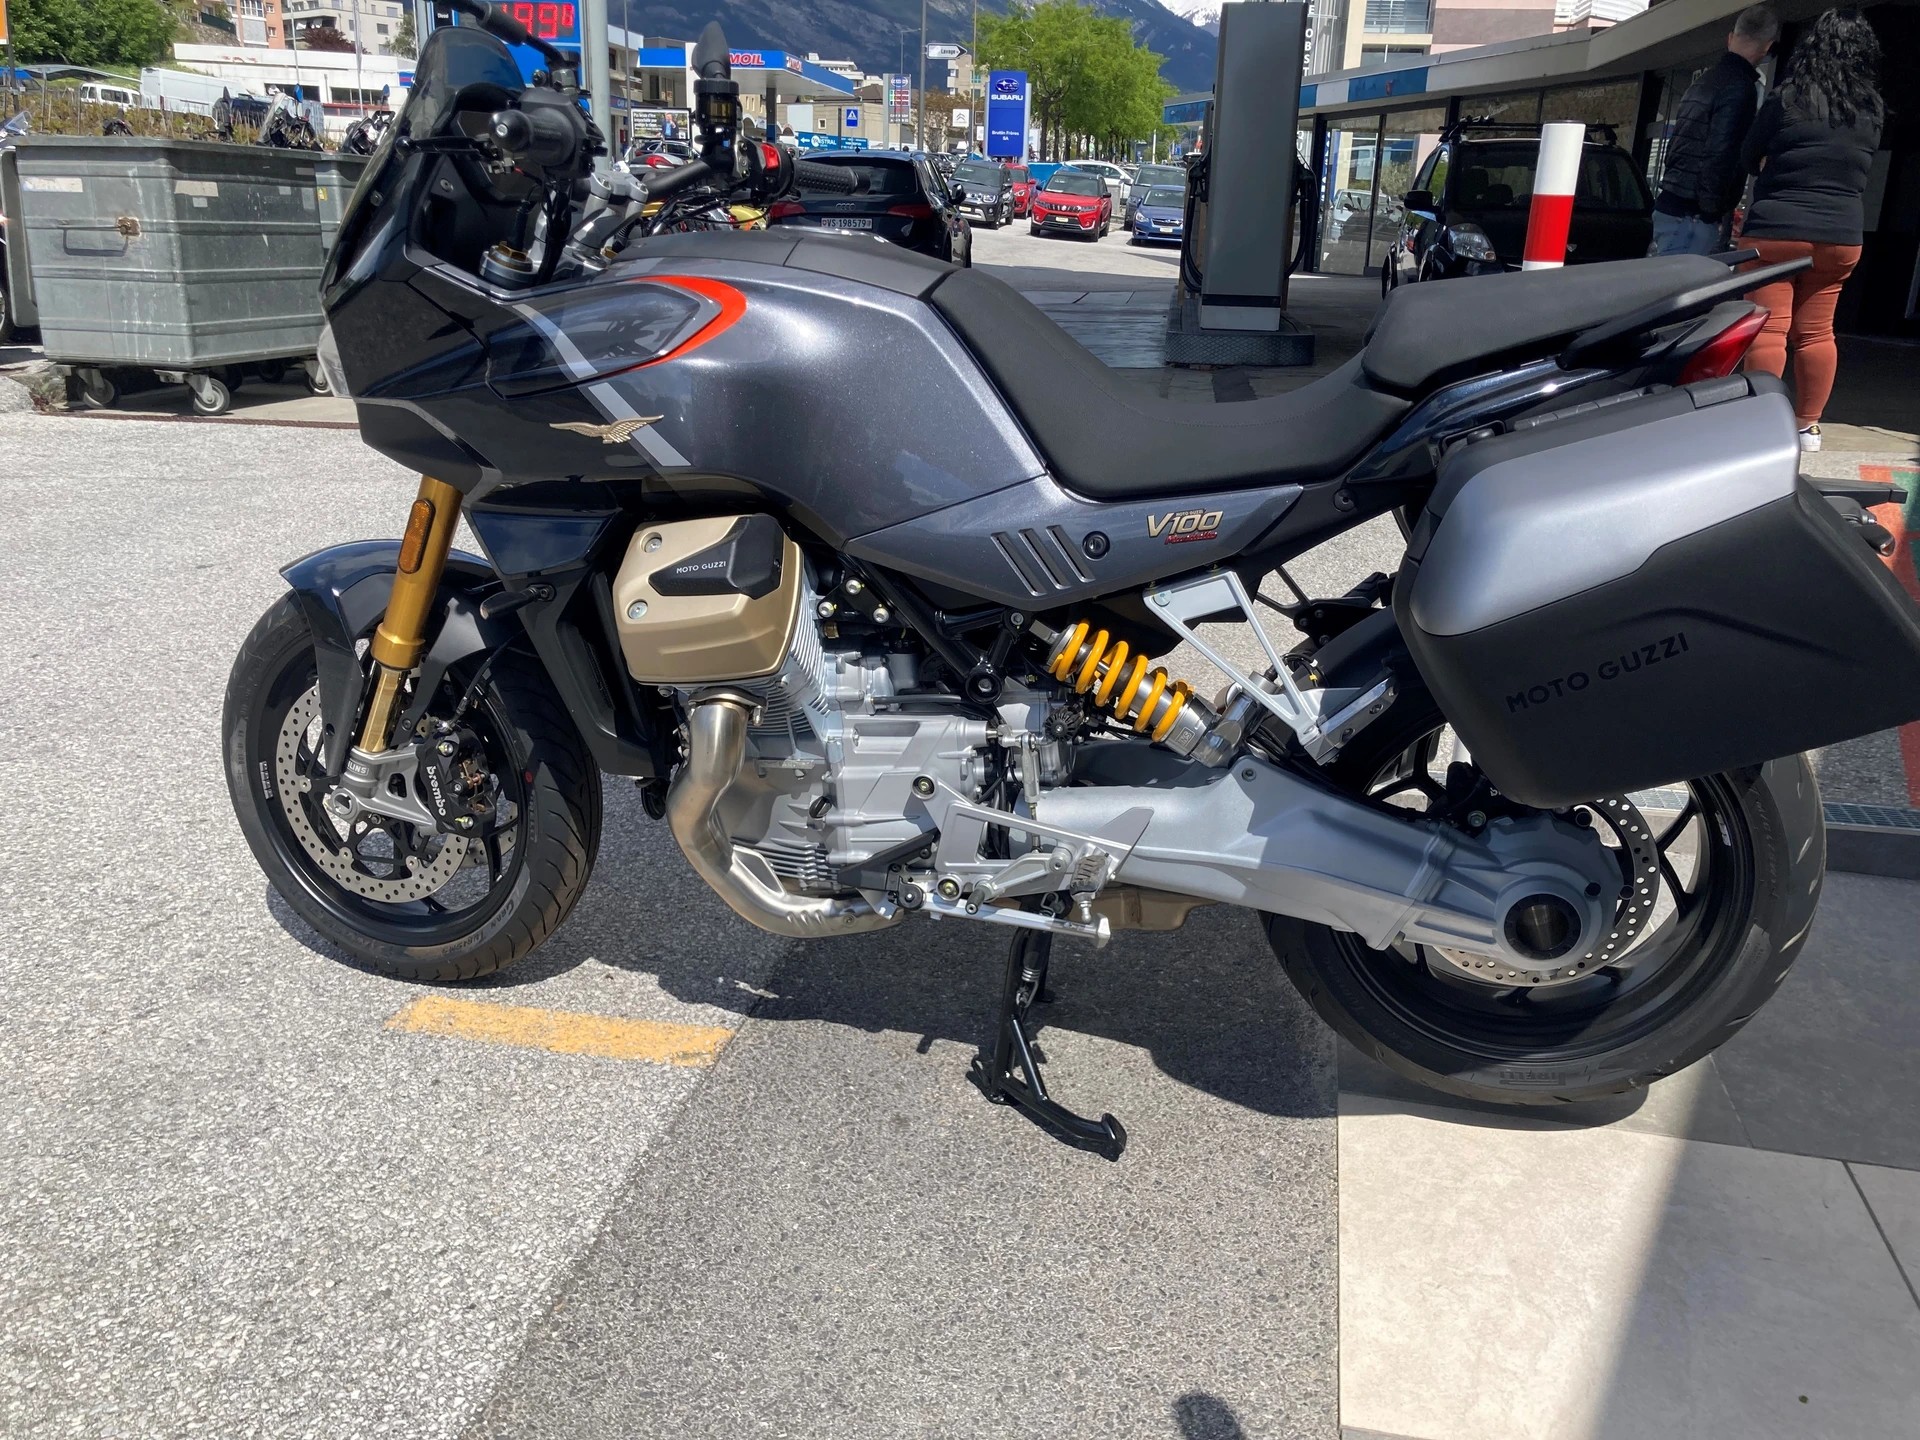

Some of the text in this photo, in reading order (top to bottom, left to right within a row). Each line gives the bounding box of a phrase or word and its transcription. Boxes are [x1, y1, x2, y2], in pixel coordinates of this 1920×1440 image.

[729, 53, 764, 66] MOIL
[827, 219, 866, 228] VS 198579
[1147, 510, 1223, 538] V100
[676, 561, 726, 574] MOTO GUZZI
[1505, 632, 1689, 713] MOTO GUZZI
[426, 765, 446, 816] brembo
